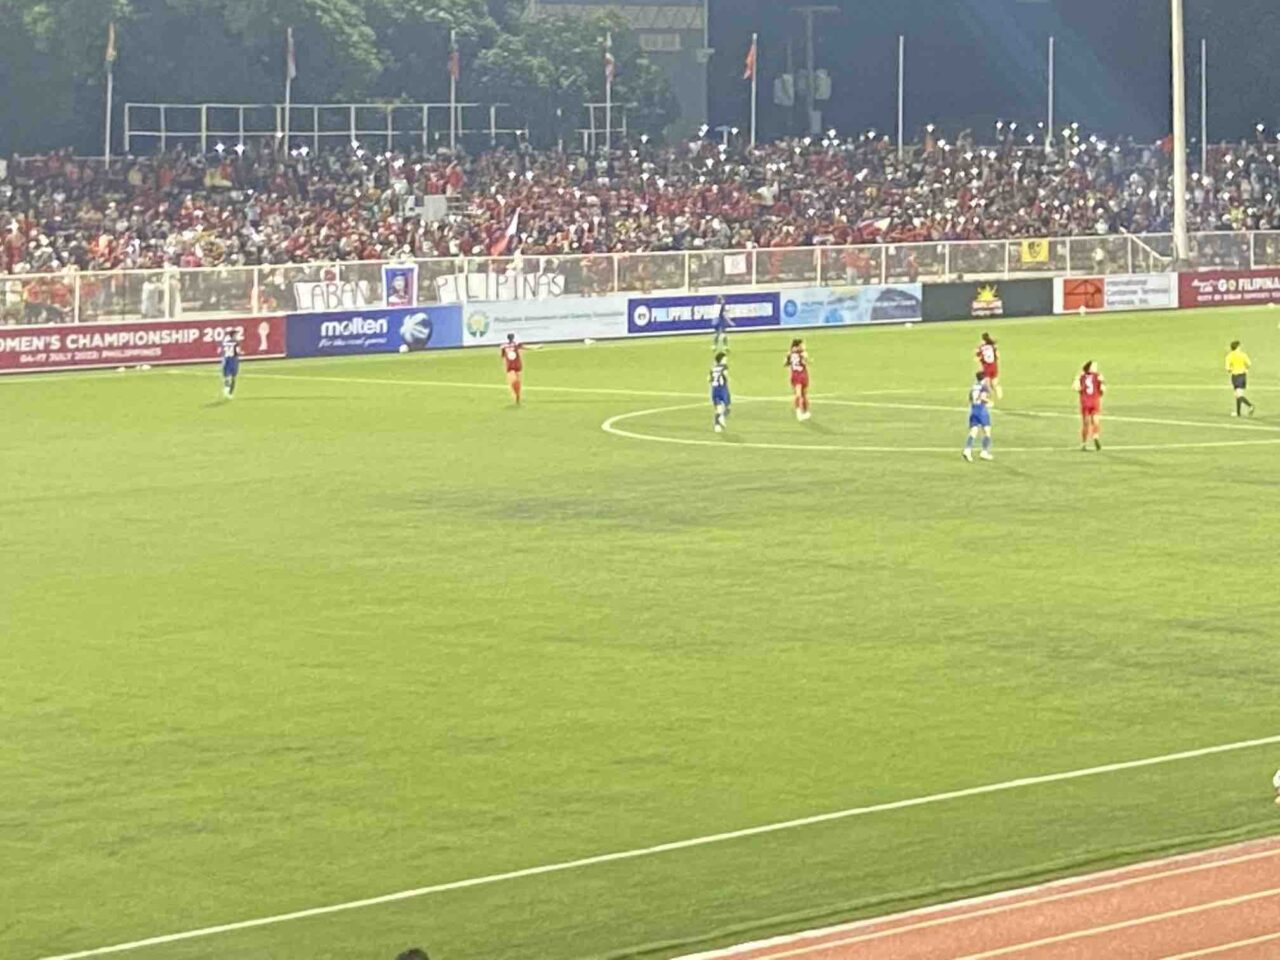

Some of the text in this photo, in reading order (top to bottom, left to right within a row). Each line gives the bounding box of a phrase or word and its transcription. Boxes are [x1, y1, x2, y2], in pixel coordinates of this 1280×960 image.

[295, 271, 567, 310] LABAN PILIPINAS
[320, 317, 388, 337] molten
[65, 328, 200, 349] CHAMPIONSHIP
